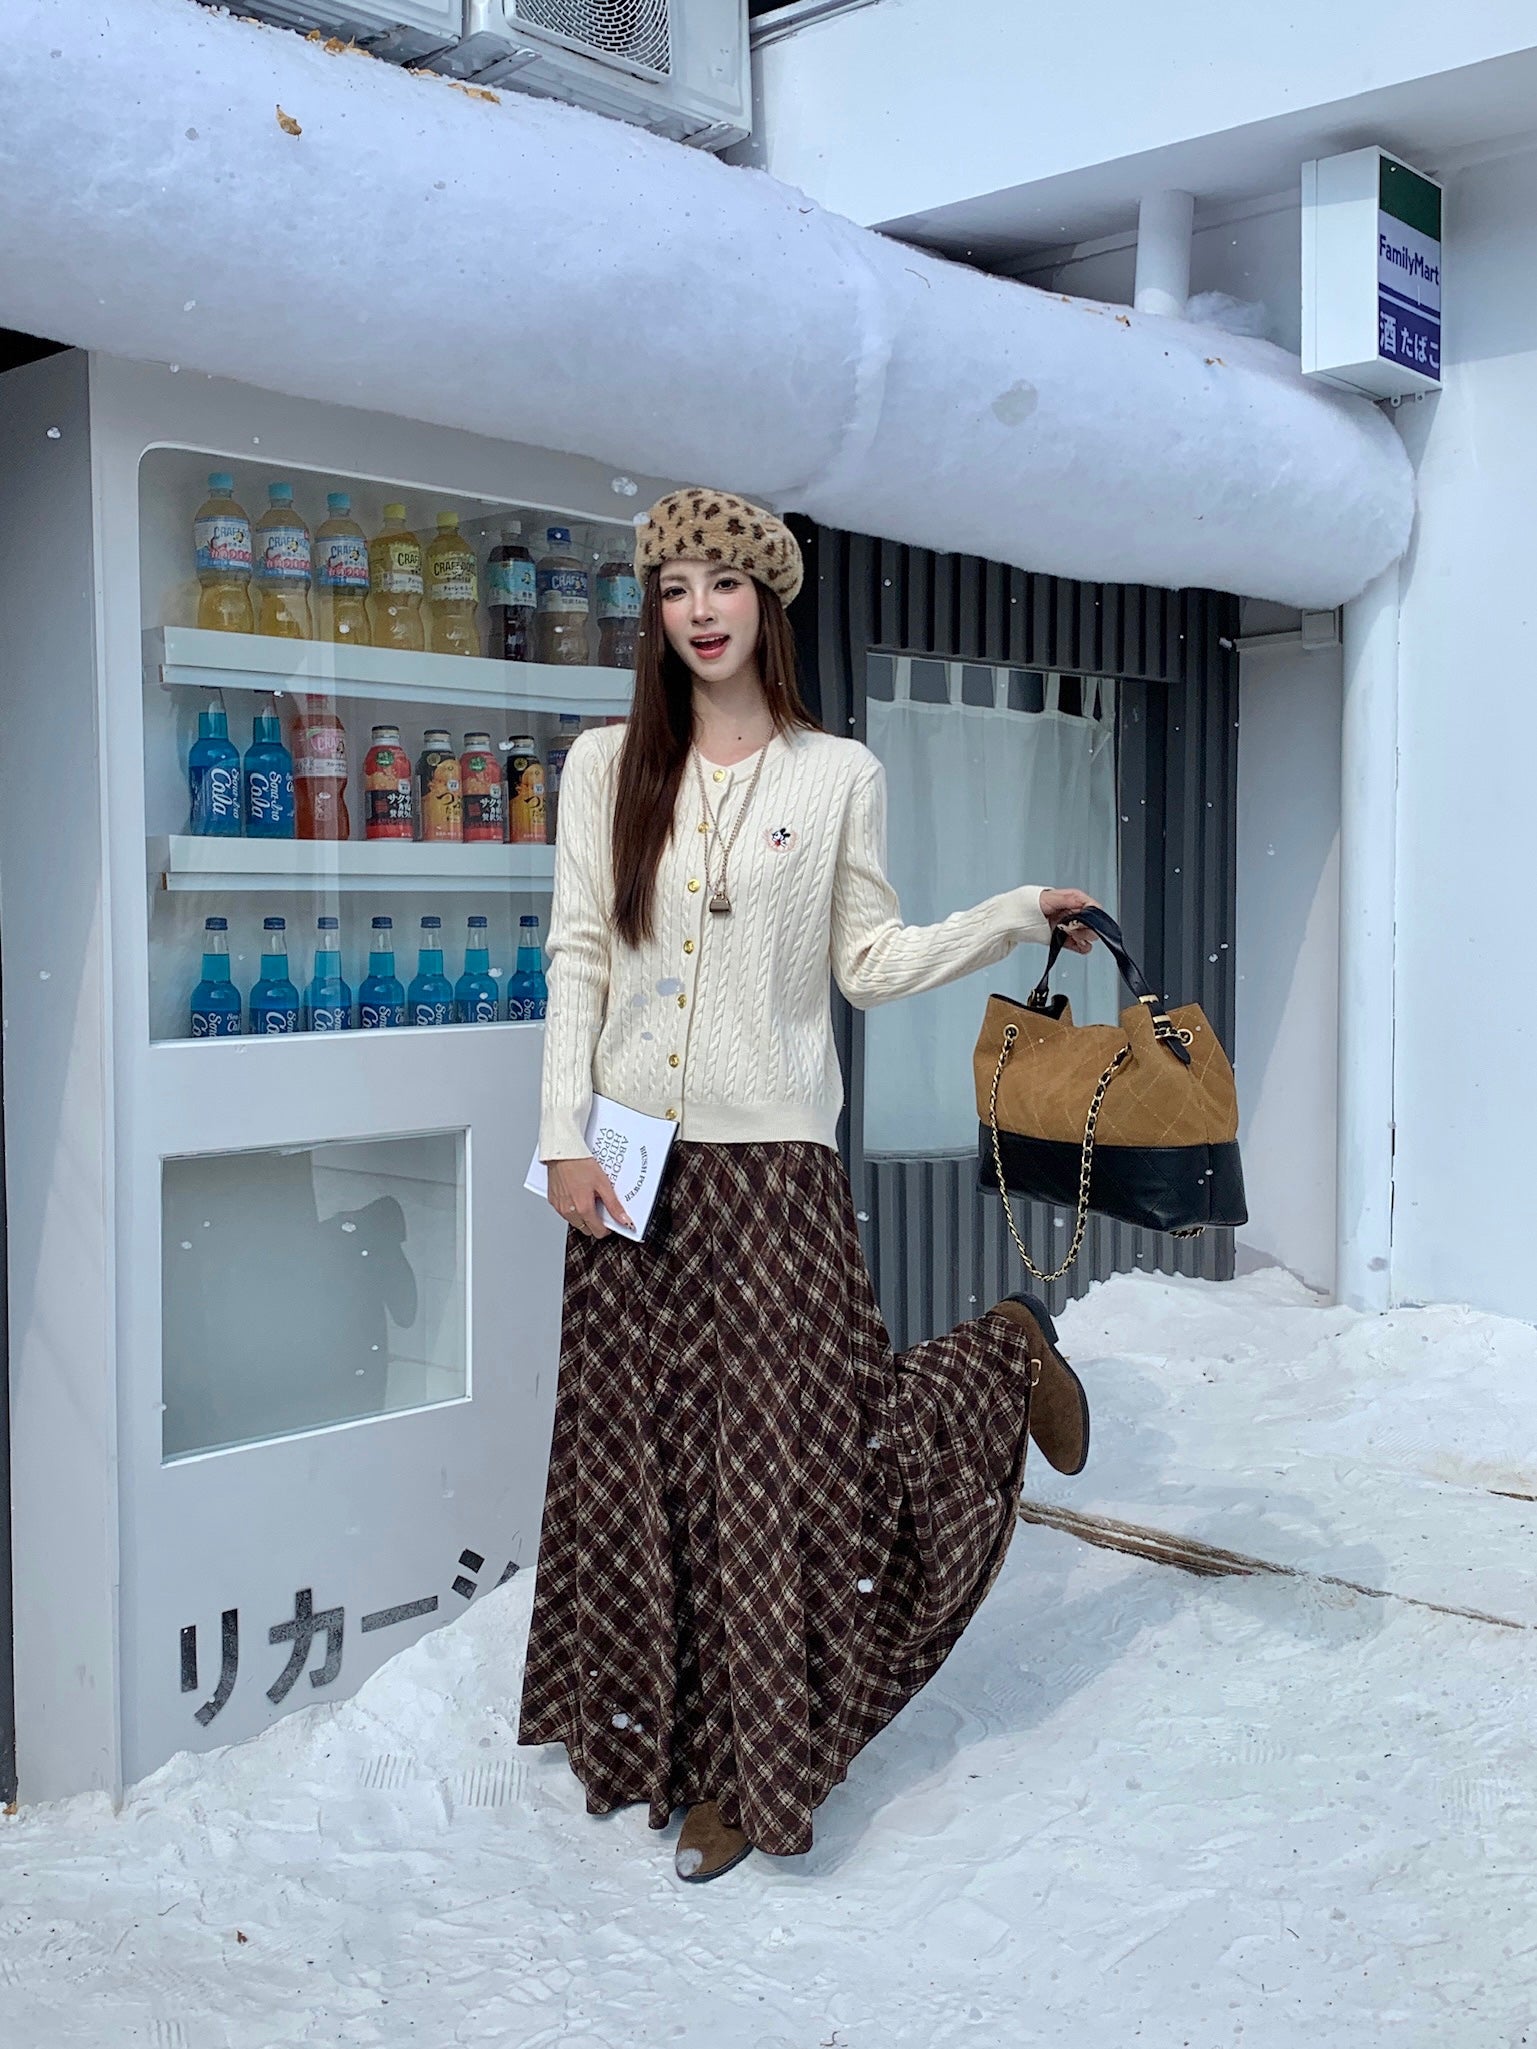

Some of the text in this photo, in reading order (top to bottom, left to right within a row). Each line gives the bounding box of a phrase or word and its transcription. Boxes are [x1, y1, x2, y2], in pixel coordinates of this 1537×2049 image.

[1379, 234, 1440, 286] FamilyMart
[1379, 312, 1440, 369] 酒 たばこ
[211, 767, 233, 816] Cola
[250, 772, 271, 819] Cola
[605, 1132, 622, 1177] HIJKL
